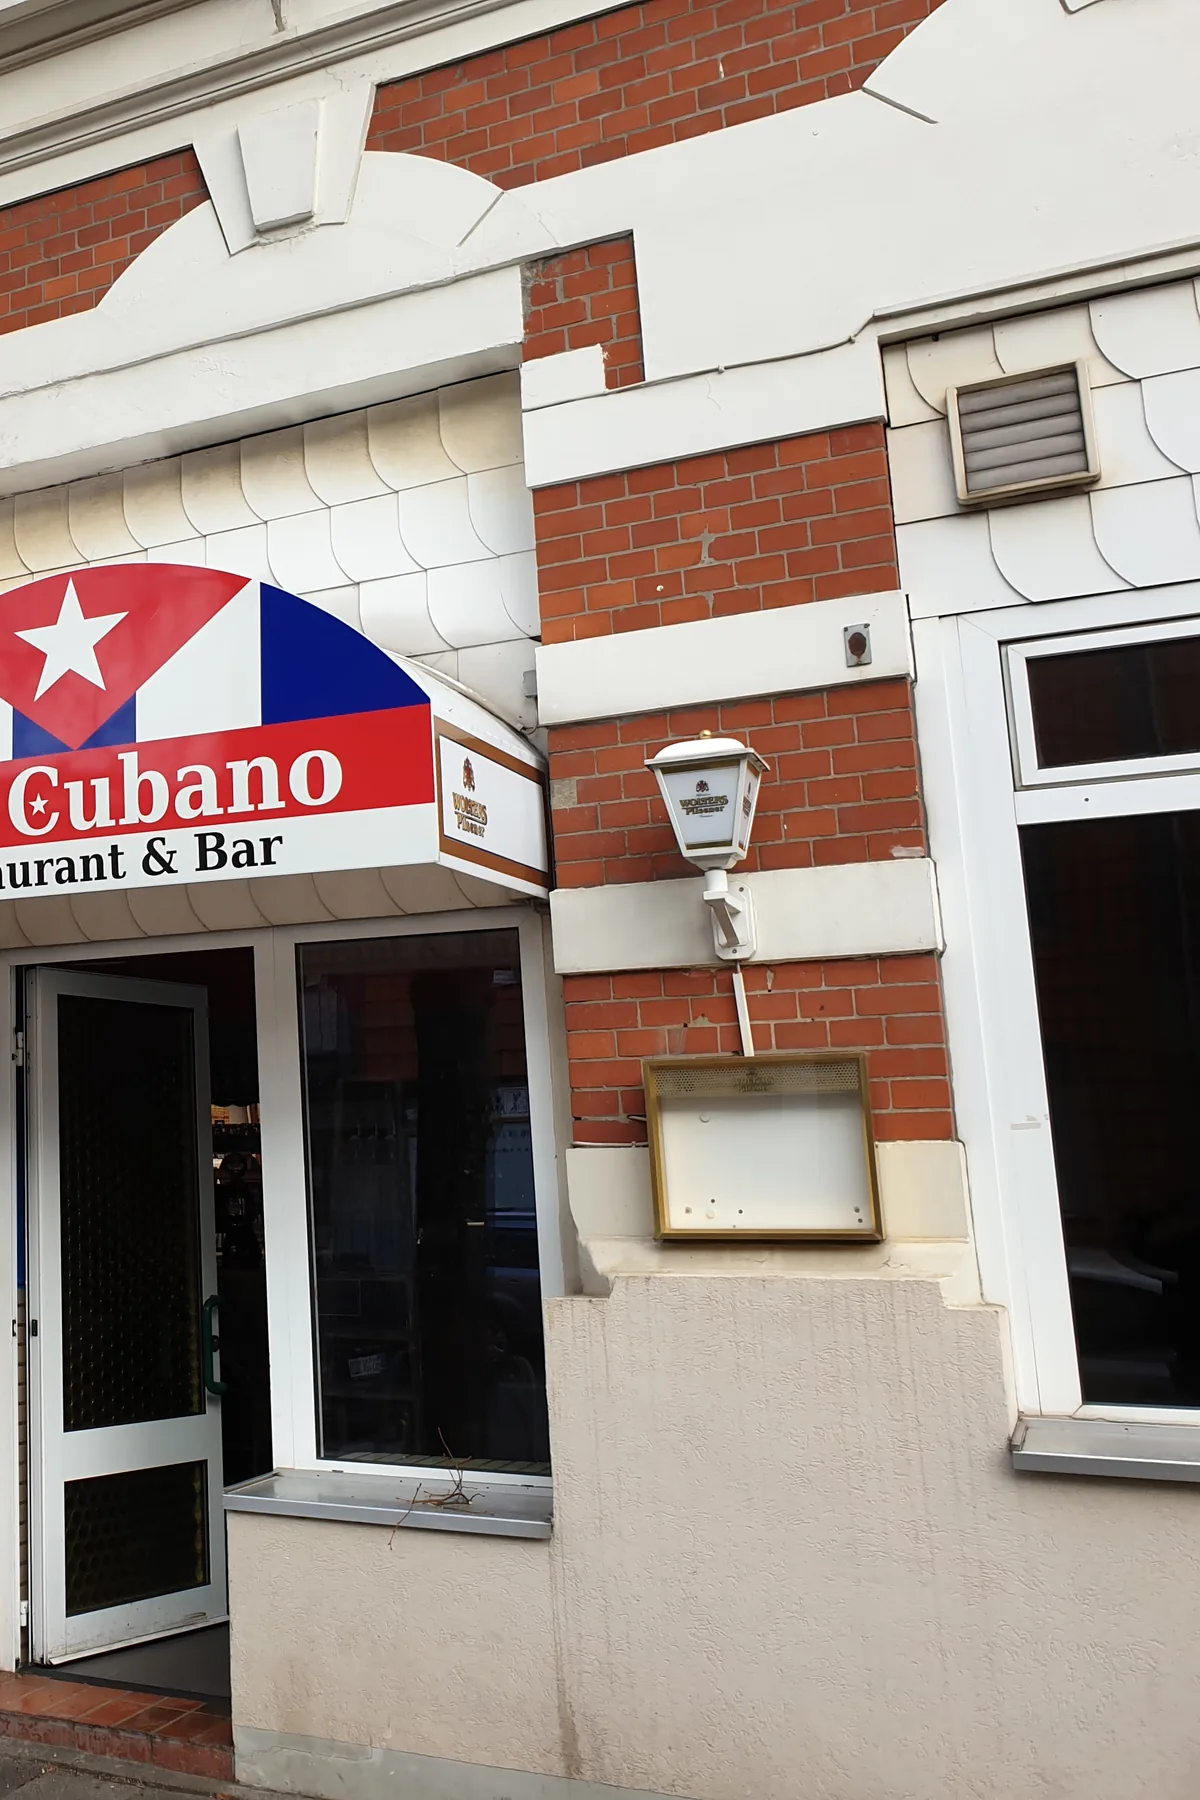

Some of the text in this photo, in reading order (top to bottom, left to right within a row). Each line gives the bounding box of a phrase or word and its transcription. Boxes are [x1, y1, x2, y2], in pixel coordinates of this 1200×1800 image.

[8, 749, 343, 836] Cubano
[679, 795, 729, 808] WOLTERS
[142, 836, 178, 876] &
[194, 831, 283, 872] Bar
